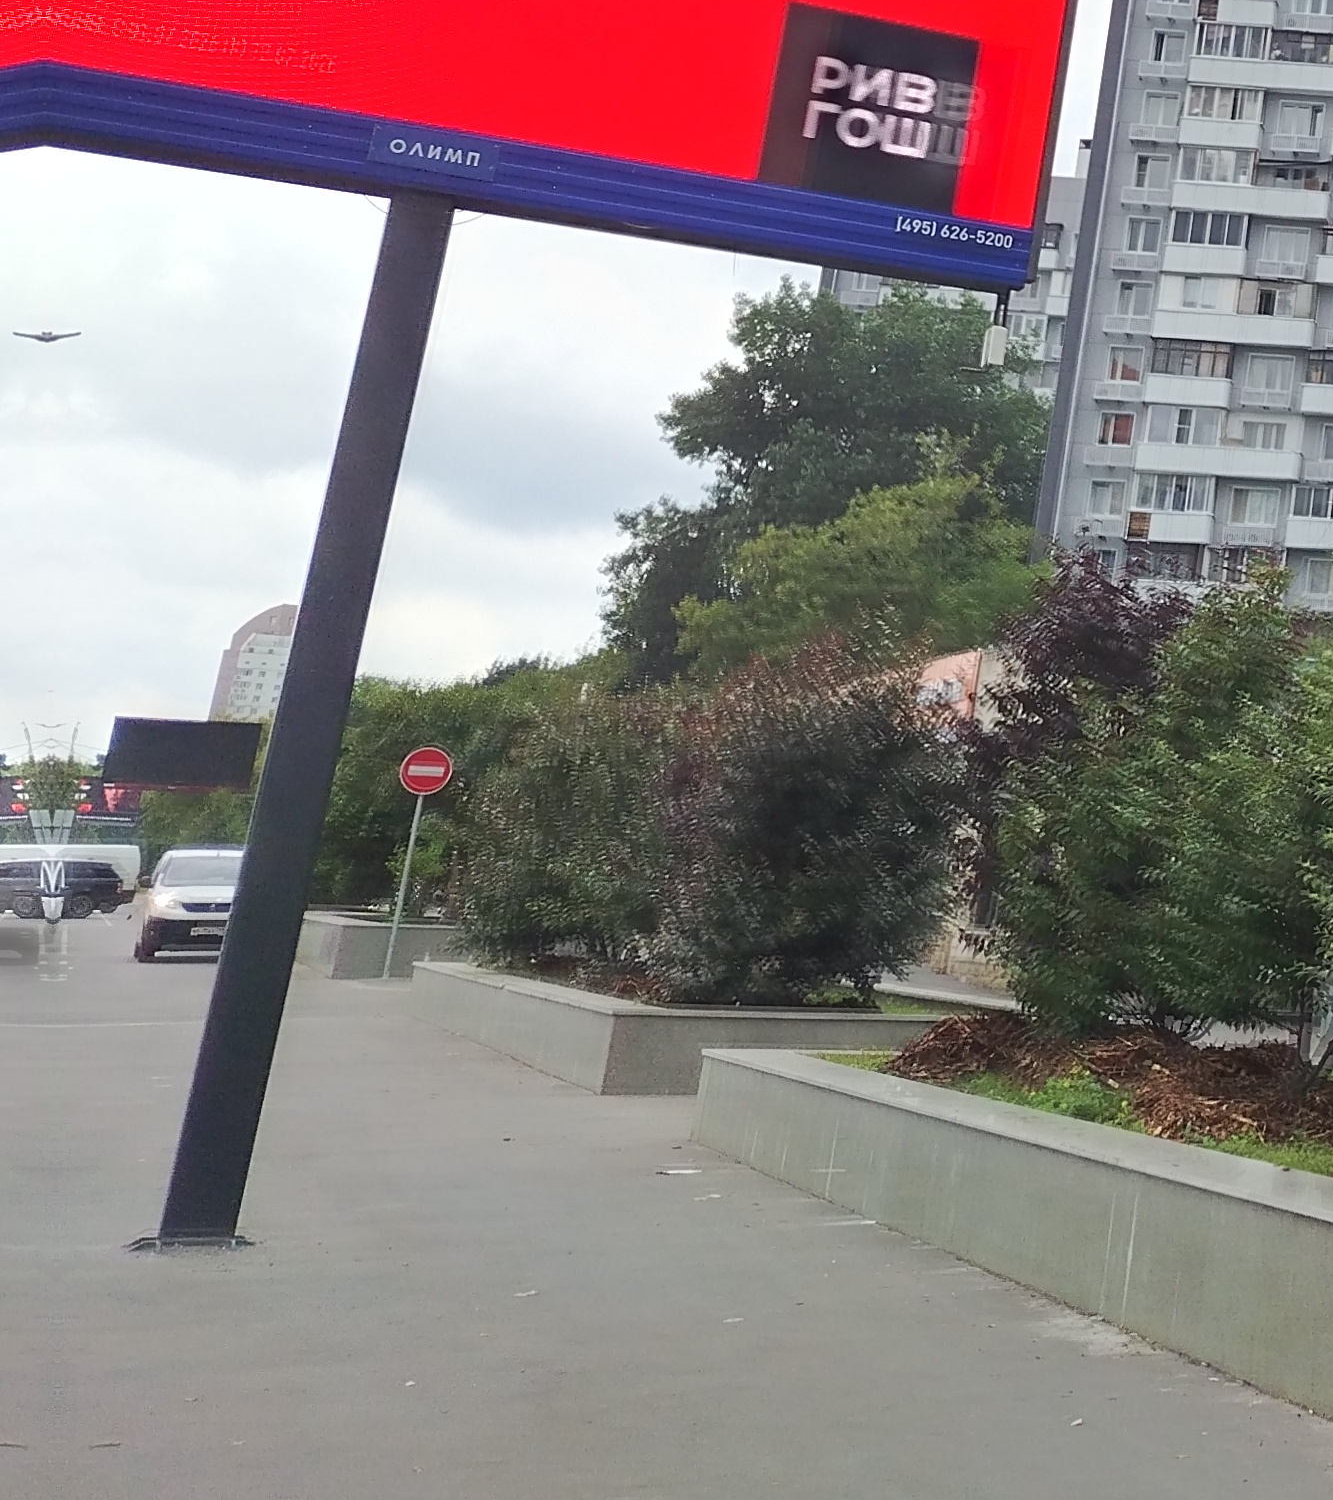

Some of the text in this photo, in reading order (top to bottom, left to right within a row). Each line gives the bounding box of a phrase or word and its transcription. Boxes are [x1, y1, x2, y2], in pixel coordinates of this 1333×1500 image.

[811, 56, 942, 117] РИВ
[389, 139, 481, 167] ОЛИМП
[802, 100, 938, 160] ГОШ
[895, 215, 1014, 250] (495) 626-5200
